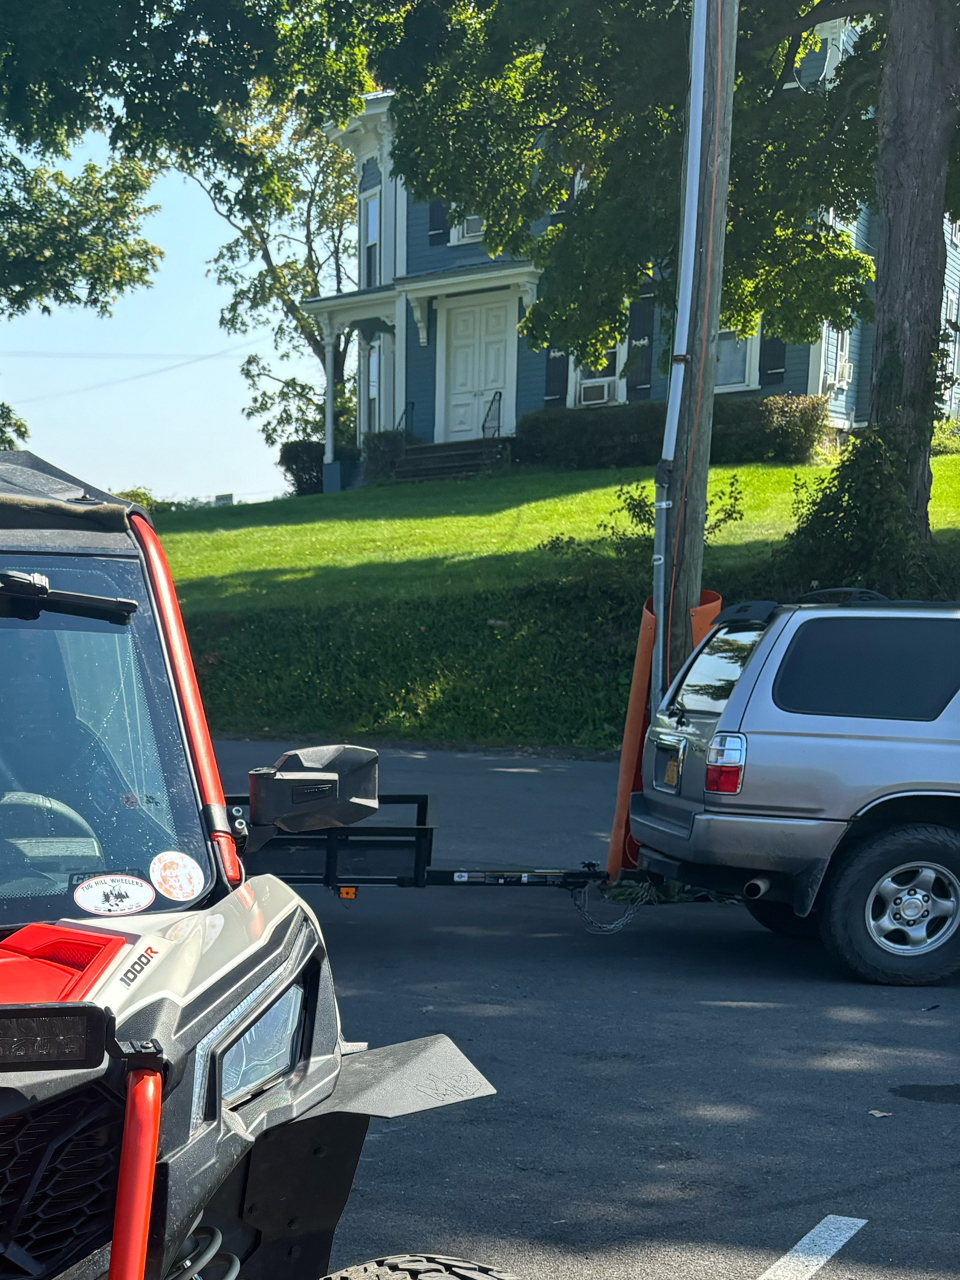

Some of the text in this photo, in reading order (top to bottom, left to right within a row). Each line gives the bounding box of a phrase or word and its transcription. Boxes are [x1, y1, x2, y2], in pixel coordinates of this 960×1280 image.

[81, 878, 144, 892] TUG HILL WHEELERS
[119, 946, 159, 988] 1000R
